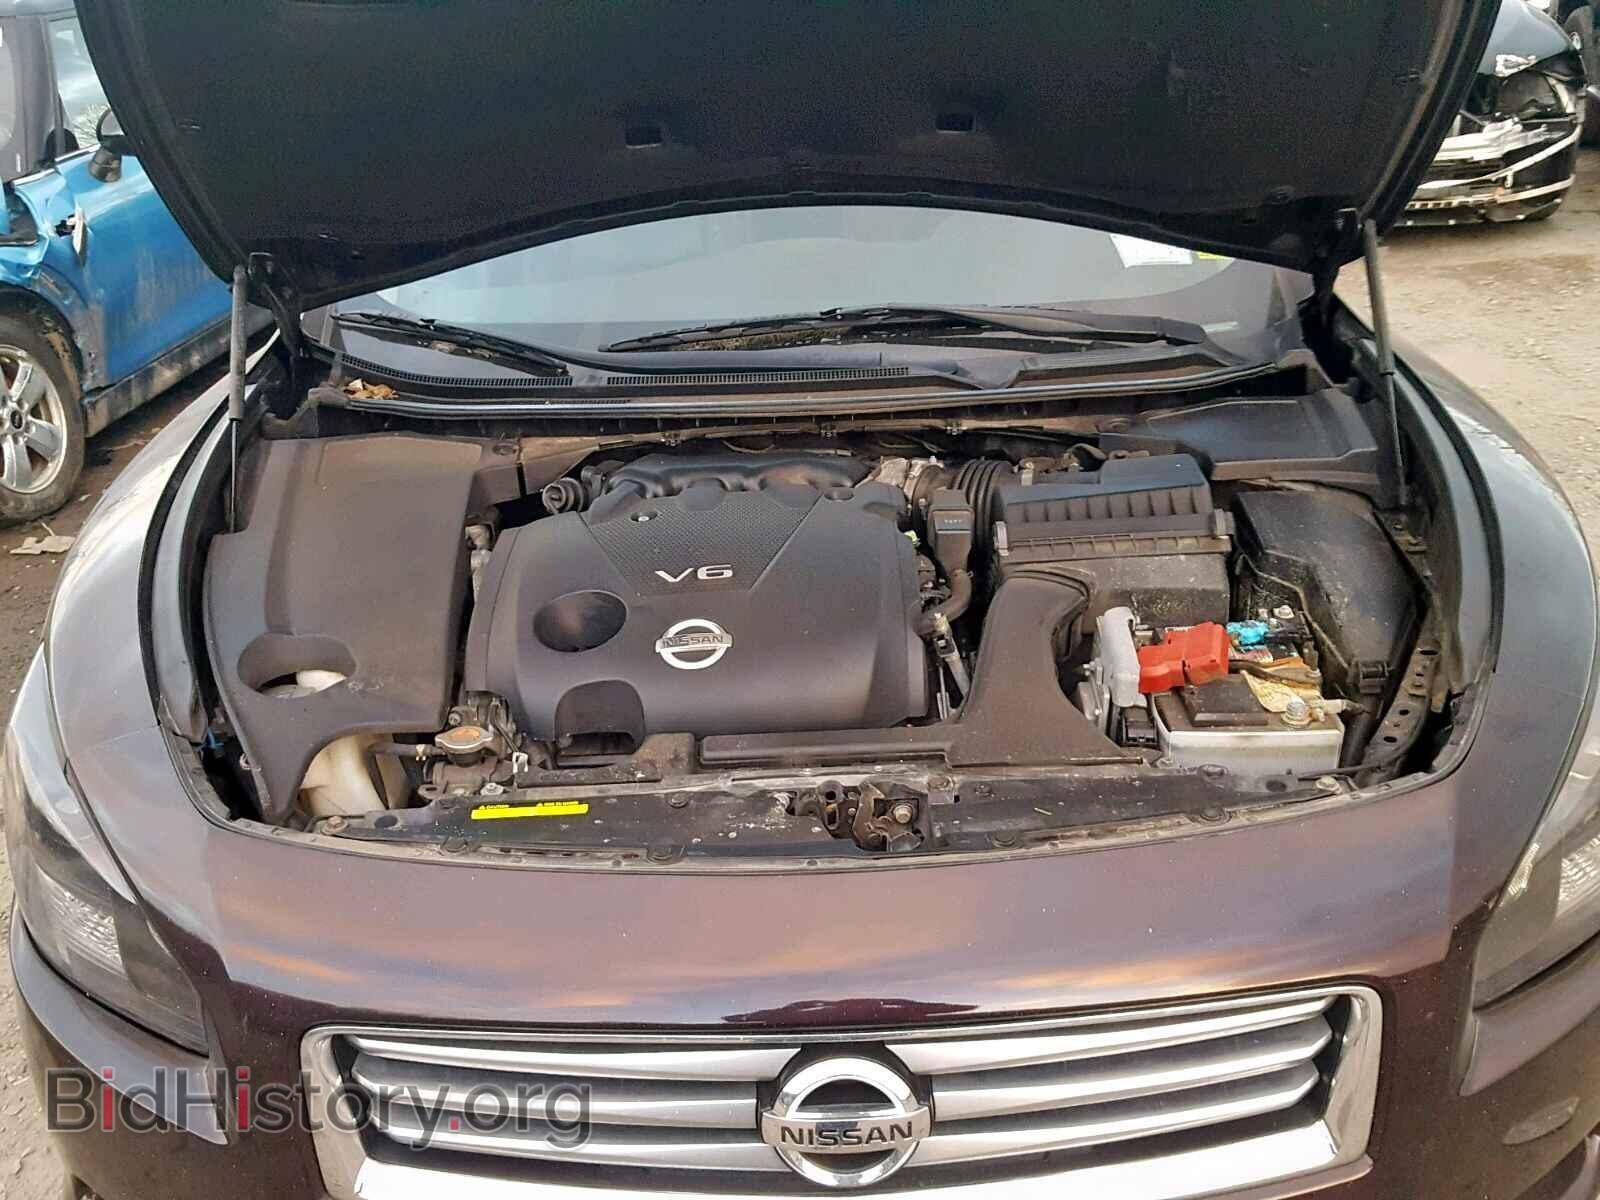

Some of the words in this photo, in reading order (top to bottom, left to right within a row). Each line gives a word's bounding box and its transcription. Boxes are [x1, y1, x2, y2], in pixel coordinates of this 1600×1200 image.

[654, 564, 733, 582] V6
[662, 634, 724, 648] NISSAN
[780, 1121, 913, 1146] NISSAN
